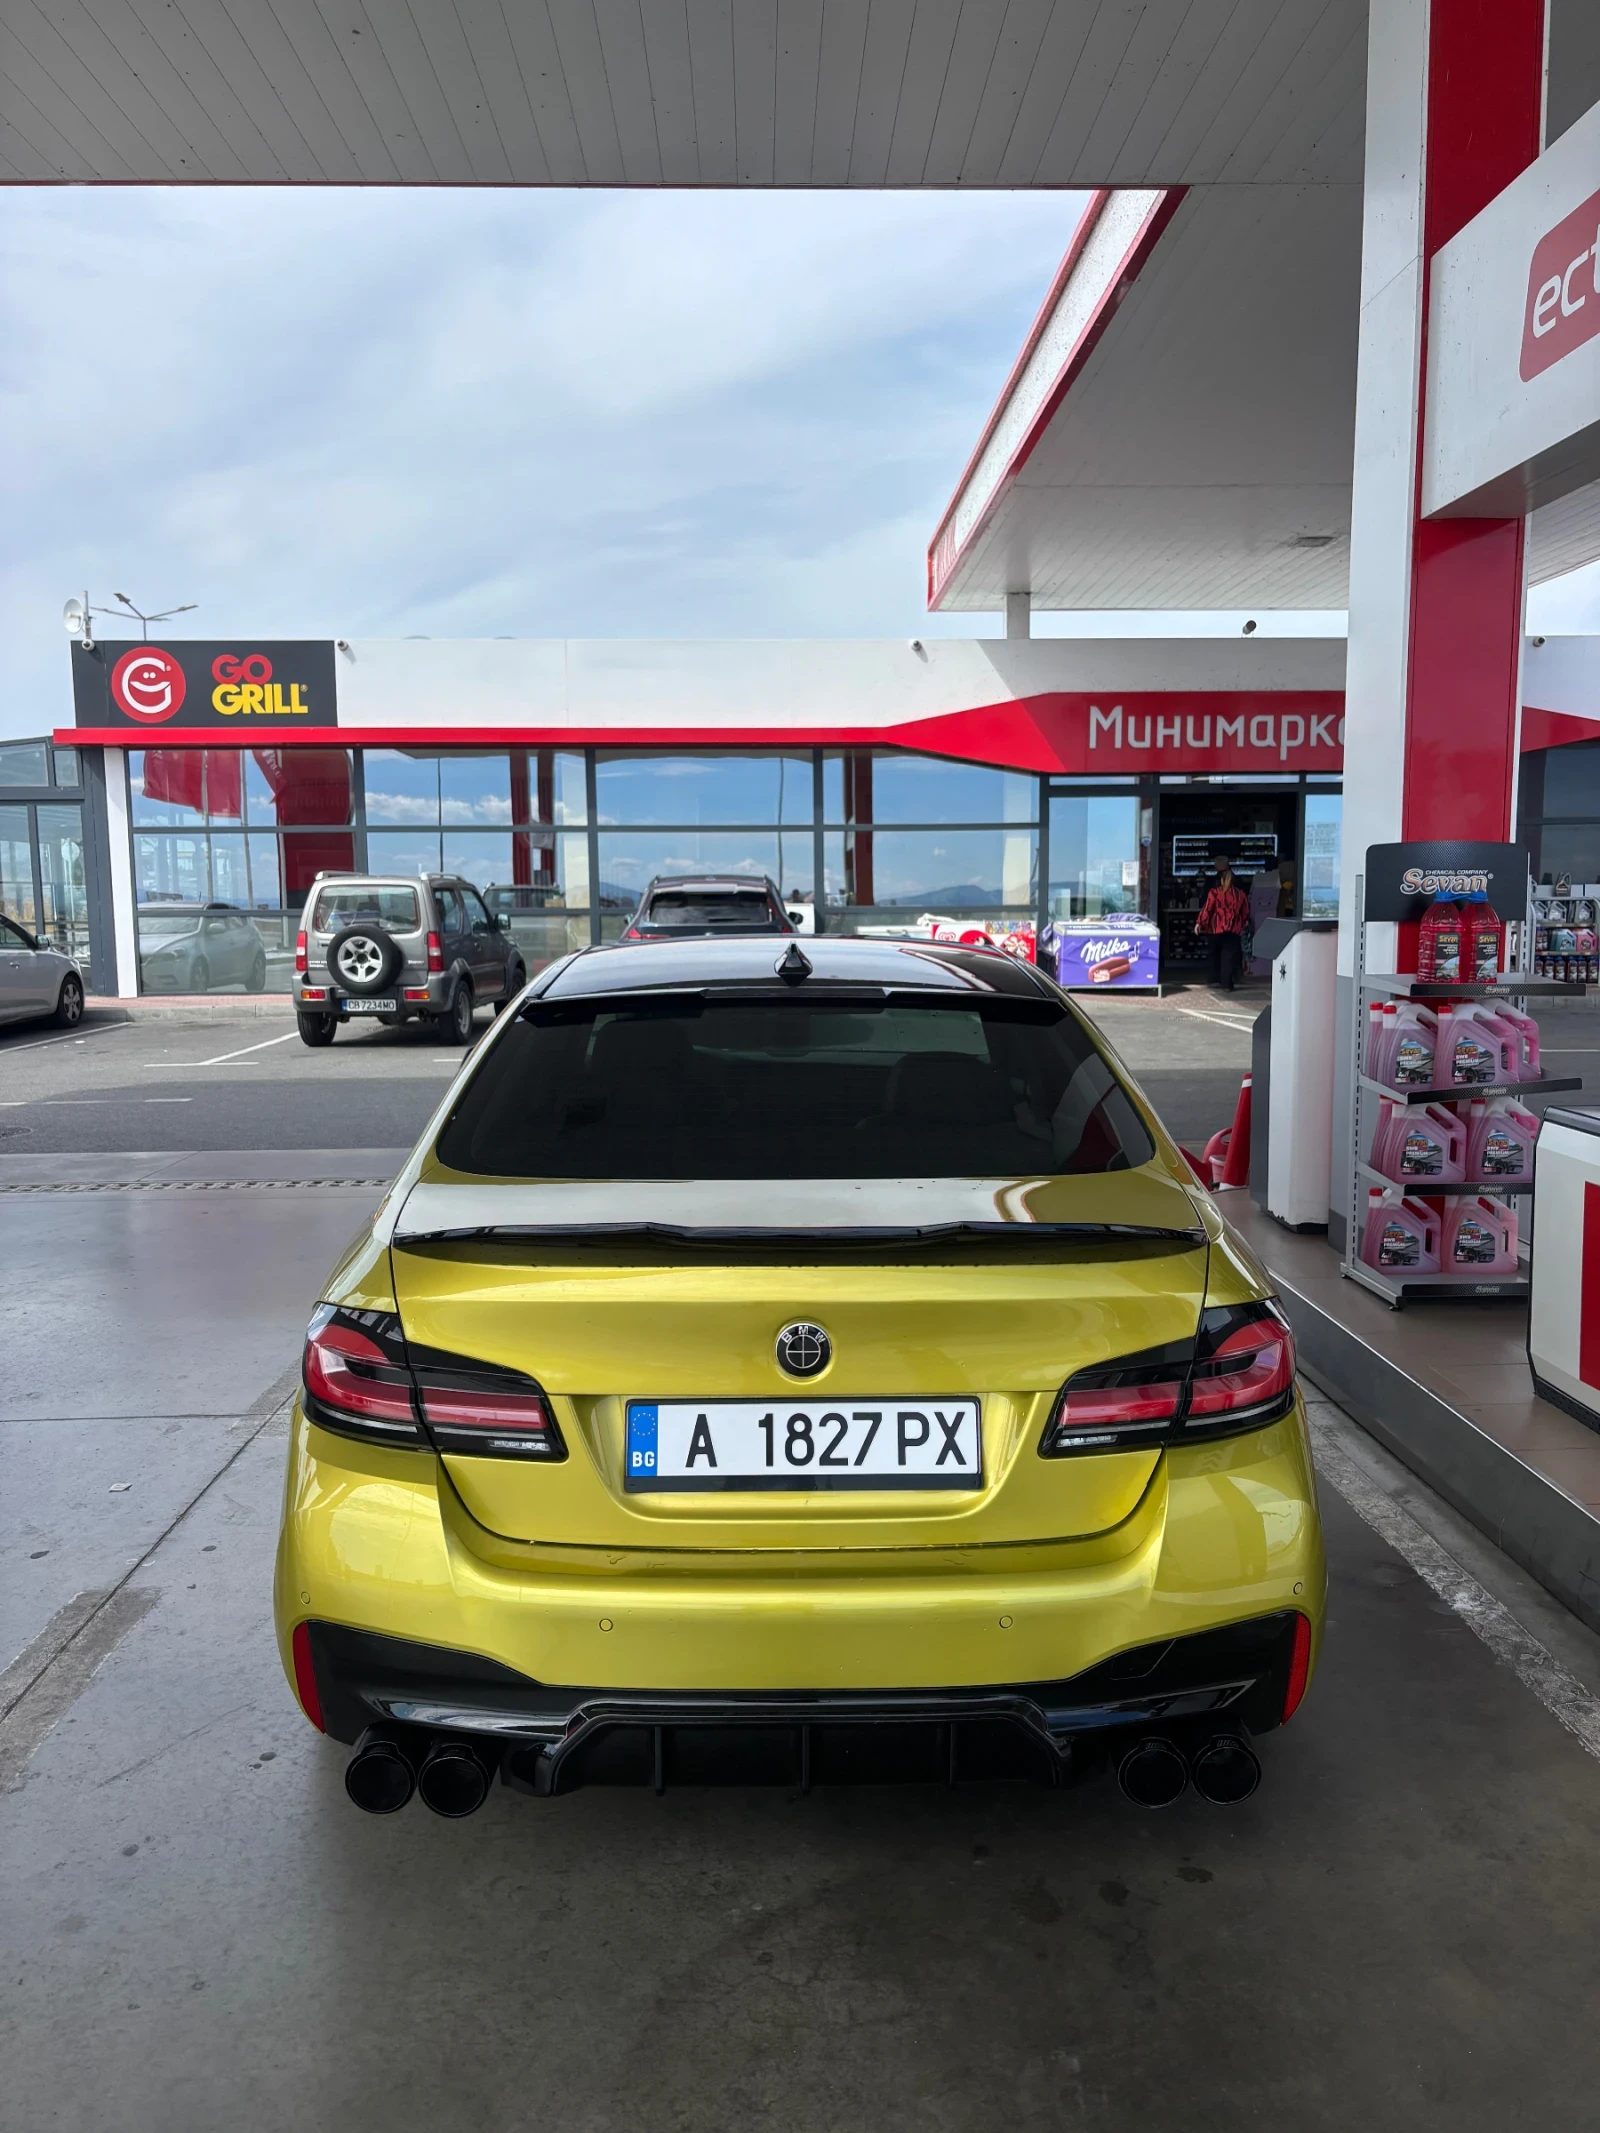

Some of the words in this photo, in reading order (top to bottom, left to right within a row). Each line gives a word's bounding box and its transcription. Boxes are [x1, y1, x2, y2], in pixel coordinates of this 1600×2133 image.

[211, 654, 273, 685] GO
[211, 683, 308, 715] GRILL
[1089, 704, 1345, 761] Минимарк
[1400, 868, 1488, 895] Sevan
[1080, 937, 1131, 963] Milka
[781, 1325, 826, 1343] BMW
[685, 1414, 718, 1468] A
[758, 1412, 883, 1467] 1827
[897, 1411, 967, 1466] PX
[632, 1451, 655, 1467] BG
